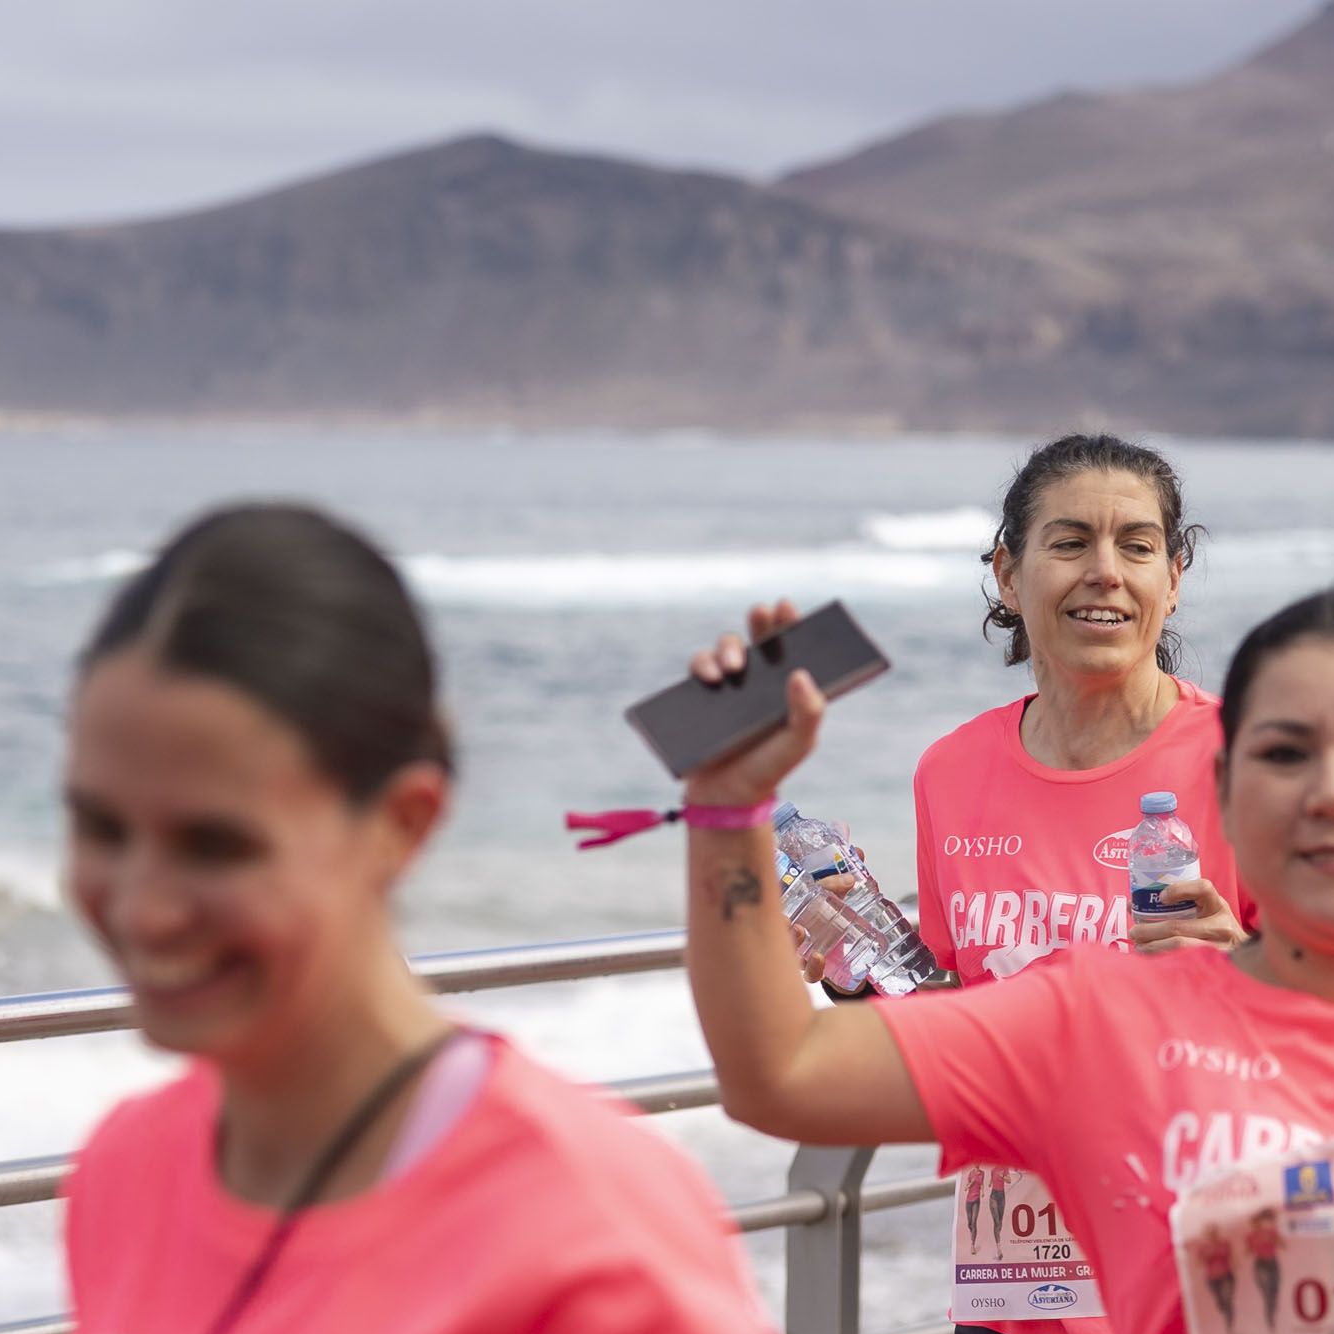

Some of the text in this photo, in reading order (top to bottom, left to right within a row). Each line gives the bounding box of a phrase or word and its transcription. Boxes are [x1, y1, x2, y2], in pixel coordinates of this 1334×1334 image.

[943, 834, 1022, 858] OYSHO
[949, 890, 1130, 953] CARRERA
[1158, 1038, 1282, 1081] OYSHO
[1011, 1202, 1057, 1238] 01
[1033, 1244, 1071, 1260] 1720
[960, 1268, 999, 1280] CARRERA
[1001, 1268, 1013, 1279] DE
[1015, 1267, 1028, 1279] LA
[1031, 1266, 1066, 1278] MUJER
[1076, 1265, 1094, 1276] GR
[971, 1298, 1005, 1308] OYSHO
[1033, 1294, 1074, 1304] ASTURIANA
